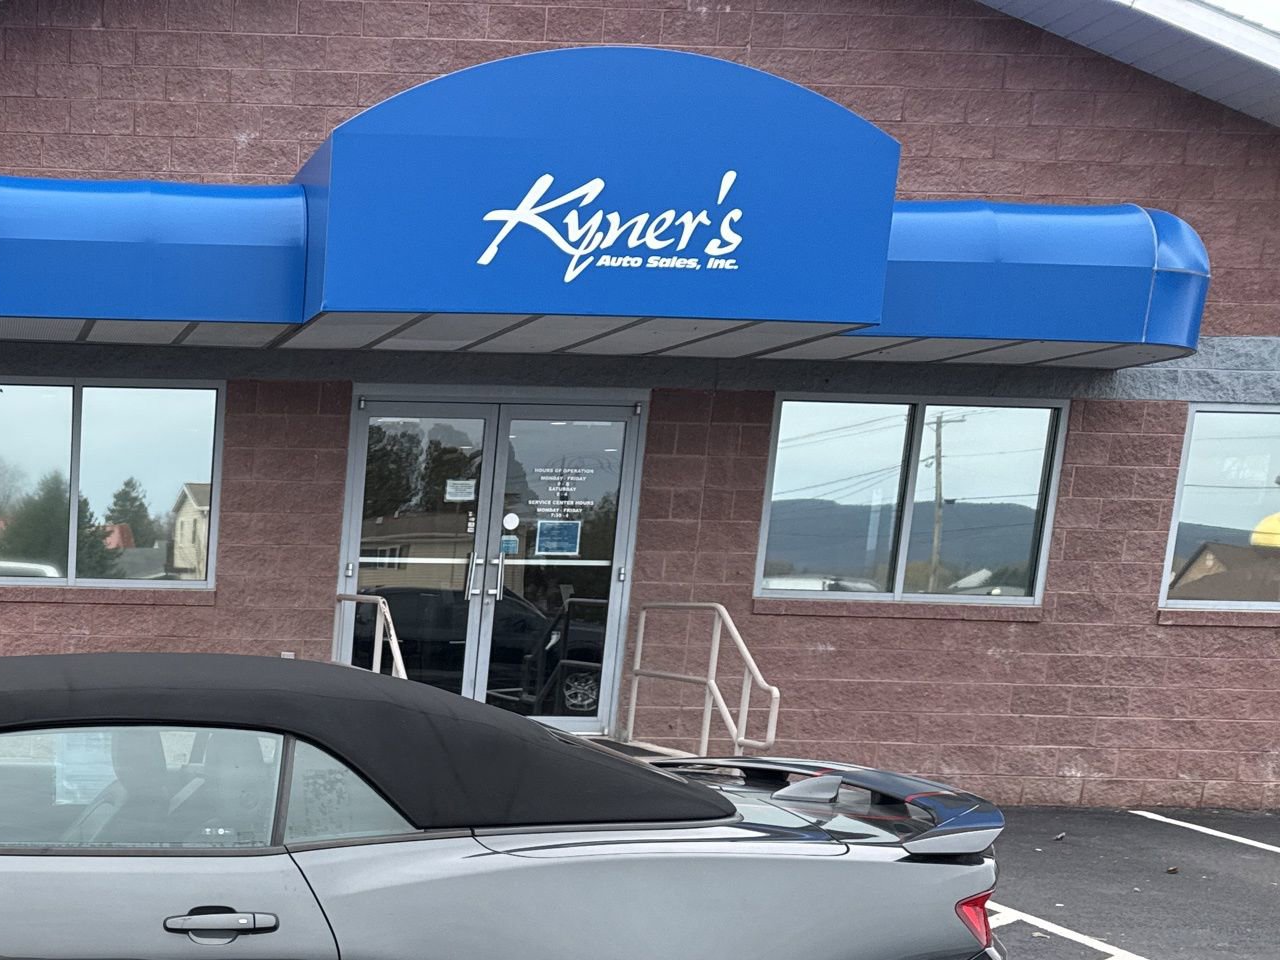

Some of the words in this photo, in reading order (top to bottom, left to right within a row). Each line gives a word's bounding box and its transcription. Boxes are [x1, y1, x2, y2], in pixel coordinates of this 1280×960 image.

[477, 170, 743, 283] Kyner's
[596, 255, 643, 268] Auto
[646, 255, 701, 270] Sales,
[707, 257, 739, 270] Inc.
